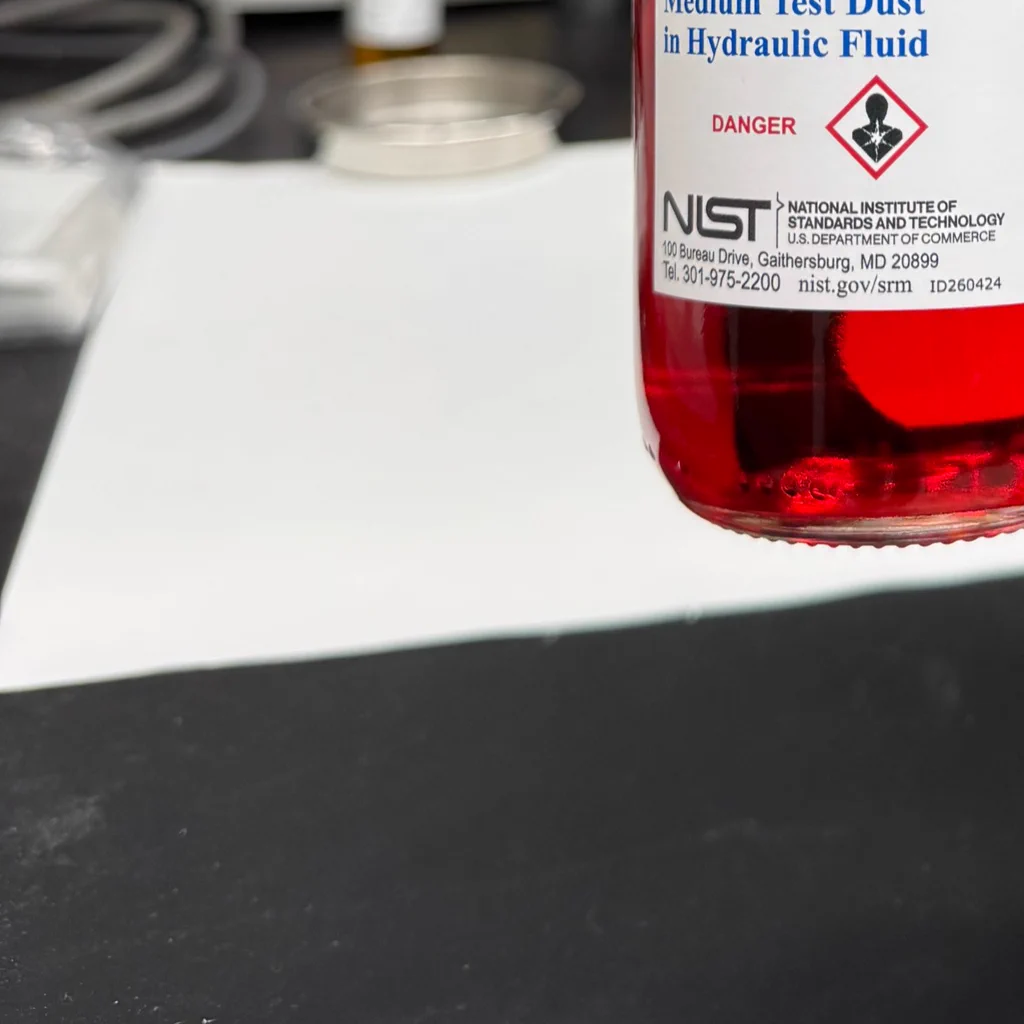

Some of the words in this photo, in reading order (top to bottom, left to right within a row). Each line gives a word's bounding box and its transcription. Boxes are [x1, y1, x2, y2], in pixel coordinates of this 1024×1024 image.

[664, 26, 680, 54] in
[687, 27, 829, 64] Hydraulic
[839, 29, 929, 58] Fluid
[712, 114, 796, 135] DANGER
[663, 190, 771, 242] NIST
[788, 201, 858, 214] NATIONAL
[860, 201, 935, 214] INSTITUTE
[937, 200, 957, 213] OF
[788, 216, 873, 229] STANDARDS
[875, 216, 906, 229] AND
[909, 213, 1005, 228] TECHNOLOGY
[788, 233, 810, 244] U.S.
[812, 233, 899, 245] DEPARTMENT
[900, 233, 919, 244] OF
[921, 230, 996, 244] COMMERCE
[663, 240, 677, 257] 100
[680, 243, 715, 263] Bureau
[718, 248, 753, 268] Drive,
[758, 251, 854, 273] Gaithersburg,
[860, 254, 886, 269] MD
[891, 253, 939, 269] 20899
[663, 260, 679, 281] Tel.
[683, 264, 781, 292] 301-975-2200
[798, 274, 913, 297] nist.gov/srm
[930, 277, 1002, 292] ID260424
